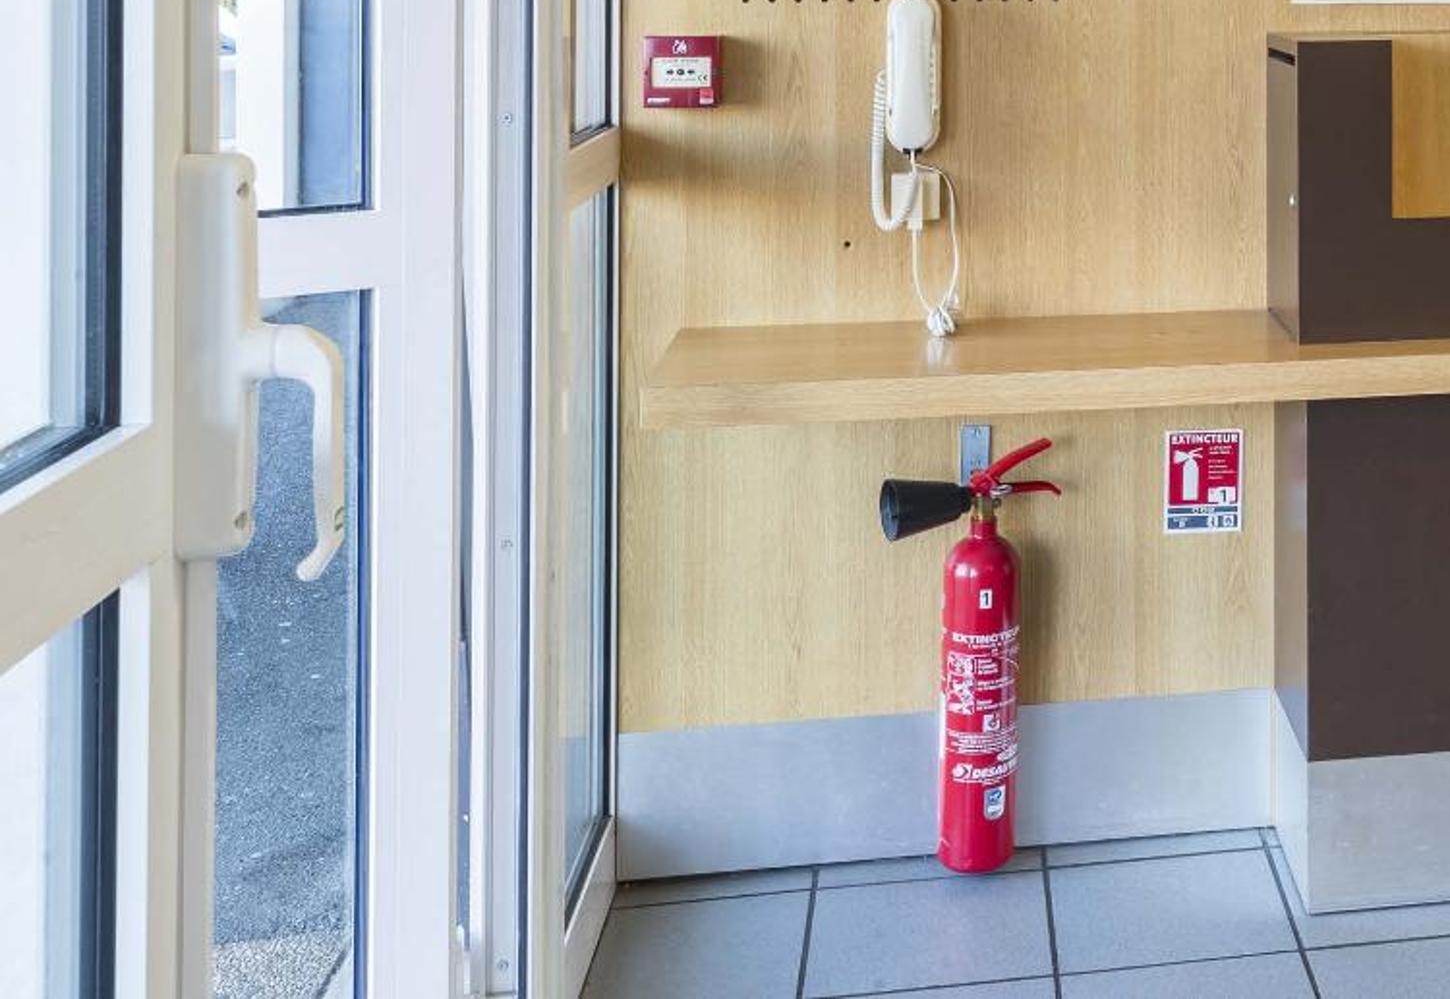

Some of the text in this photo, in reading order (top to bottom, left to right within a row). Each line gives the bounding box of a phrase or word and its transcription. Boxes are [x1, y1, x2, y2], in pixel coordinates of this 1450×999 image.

[1171, 433, 1239, 445] EXTINCTEUR
[1219, 489, 1227, 503] 1
[982, 592, 989, 607] 1
